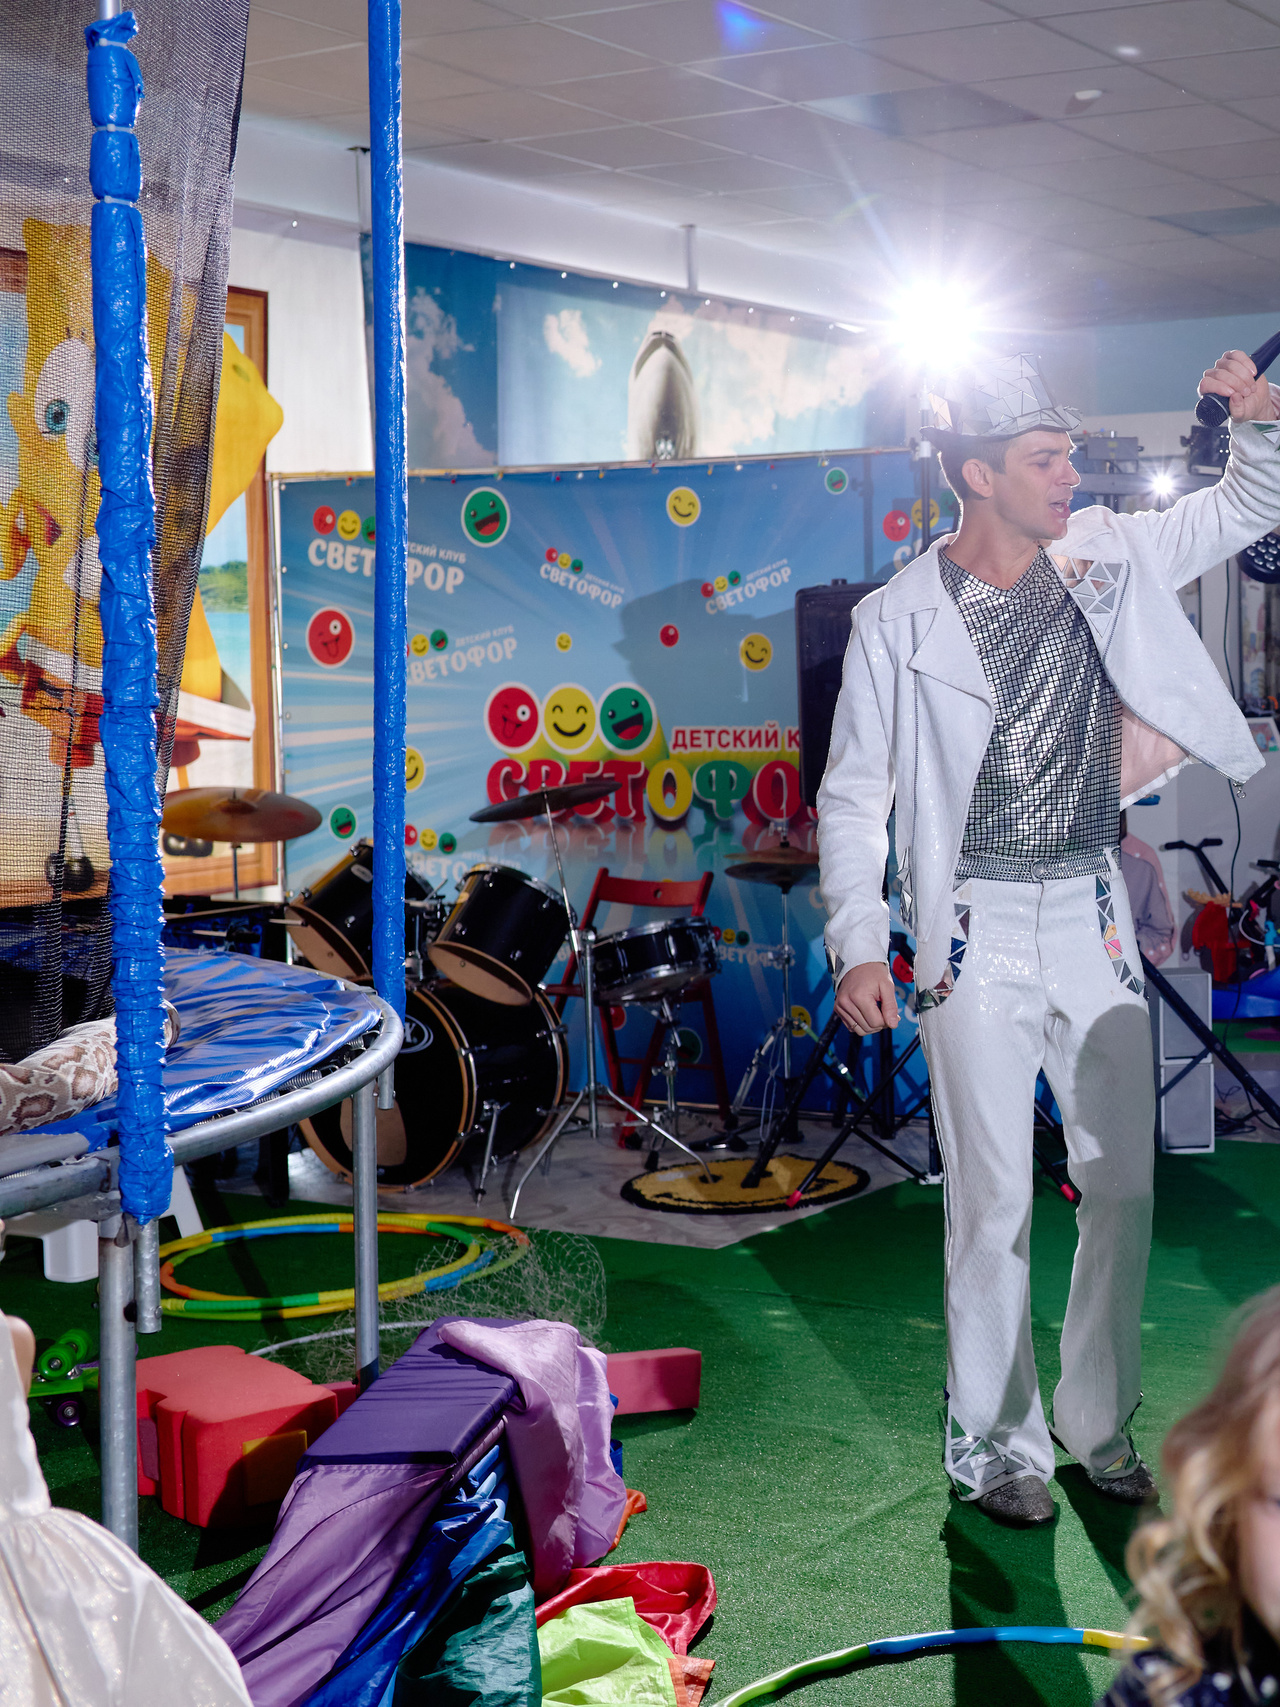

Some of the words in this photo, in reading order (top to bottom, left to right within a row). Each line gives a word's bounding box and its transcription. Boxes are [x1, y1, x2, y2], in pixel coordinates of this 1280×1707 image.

[307, 537, 465, 595] СВЕТФОР
[439, 549, 467, 564] КЛУБ
[540, 563, 623, 609] СВЕТОФОР
[705, 566, 792, 615] СВЕТОФОР
[406, 637, 517, 684] ВЕТОФОР
[672, 721, 779, 750] ДЕТСКИЙ
[486, 758, 801, 823] СВЕТОФО
